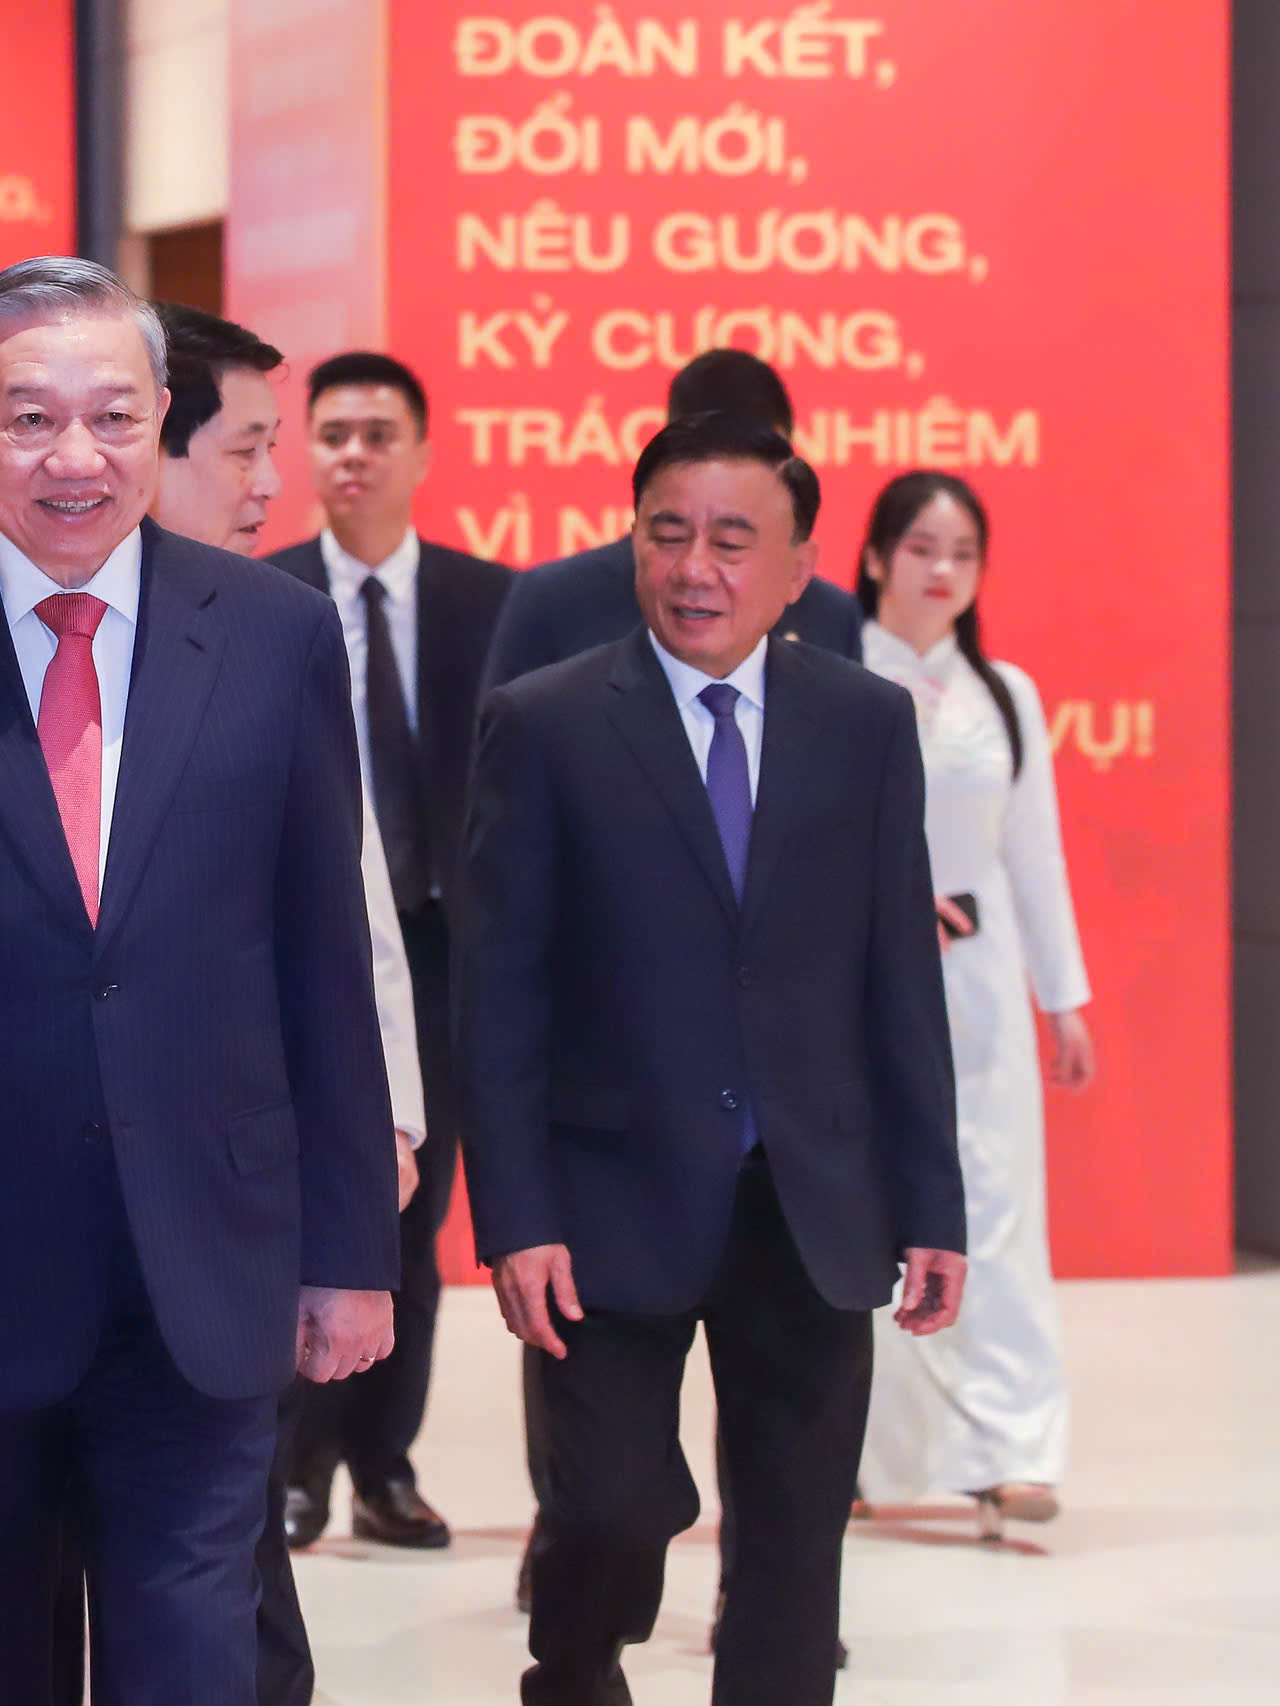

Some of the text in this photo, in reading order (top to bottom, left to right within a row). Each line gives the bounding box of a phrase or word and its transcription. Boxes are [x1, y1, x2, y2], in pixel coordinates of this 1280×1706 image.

[455, 1, 897, 88] ĐOÀN KẾT,
[455, 91, 809, 185] ĐỔI MỚI,
[456, 197, 989, 284] NÊU GƯƠNG,
